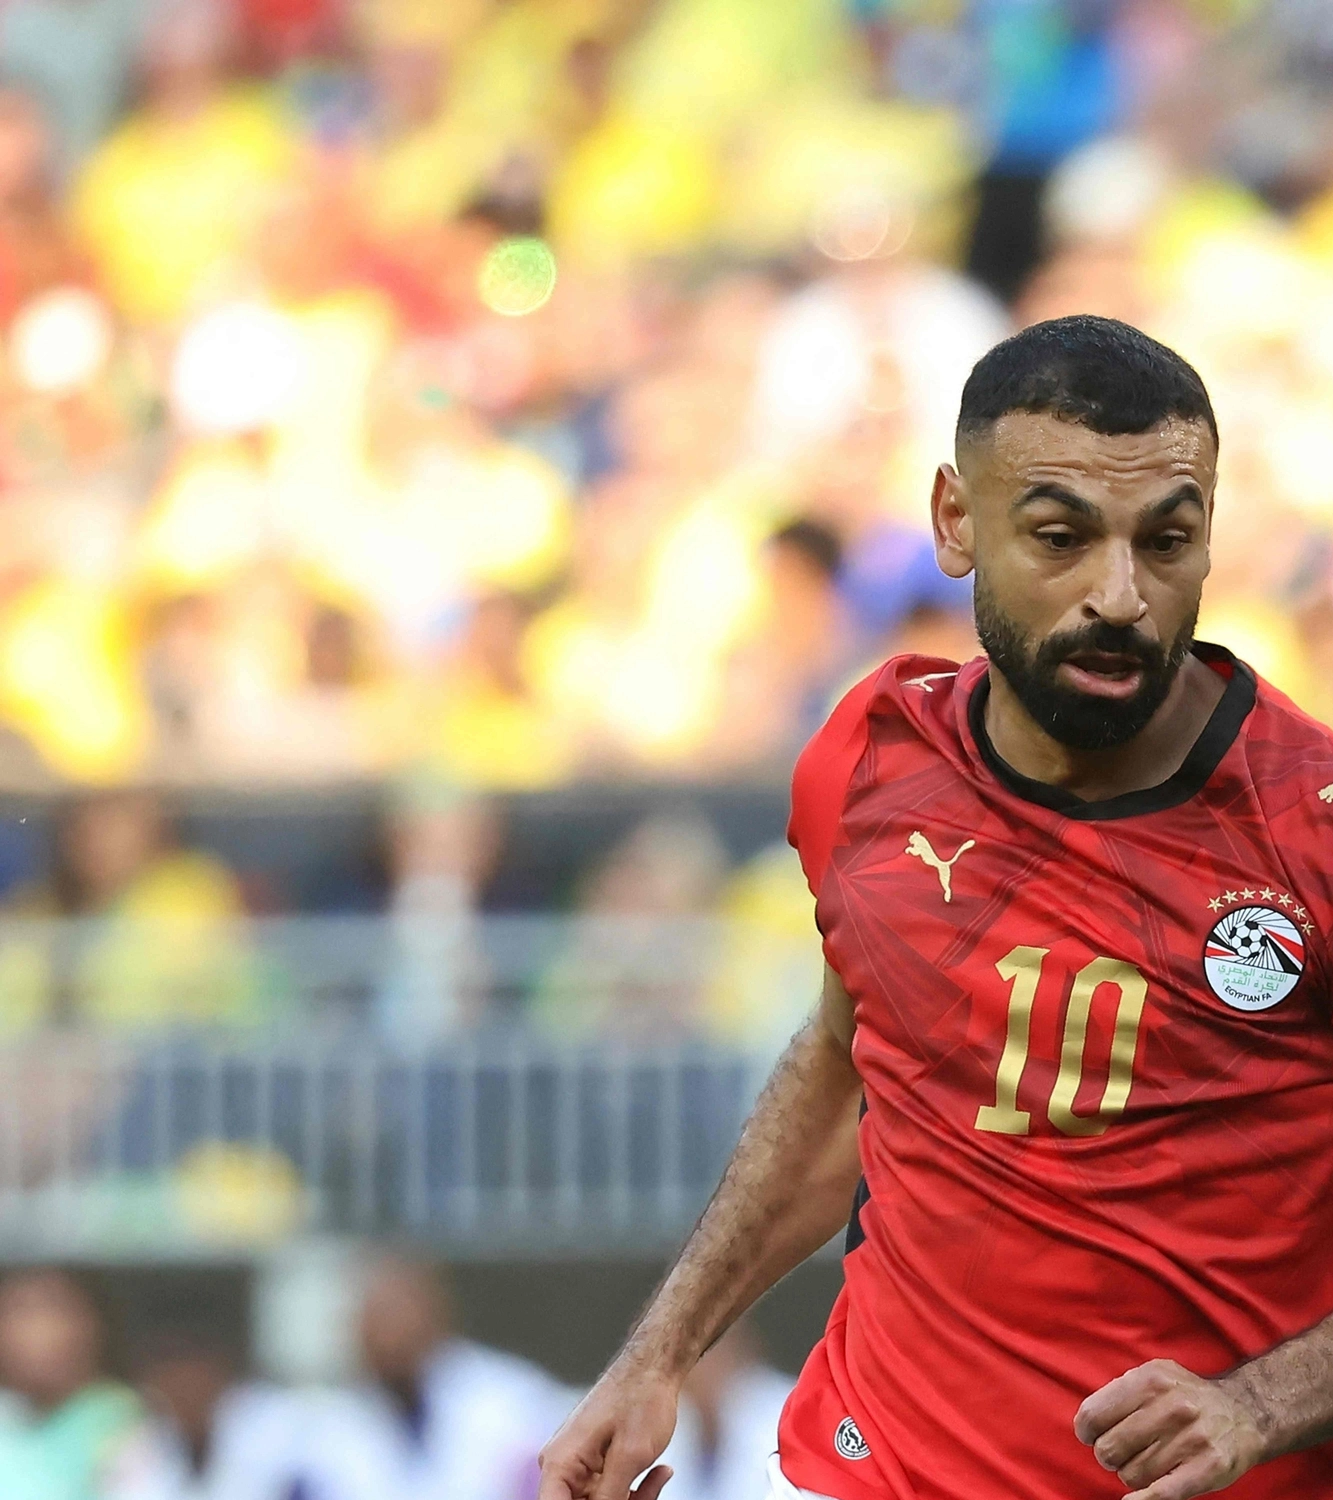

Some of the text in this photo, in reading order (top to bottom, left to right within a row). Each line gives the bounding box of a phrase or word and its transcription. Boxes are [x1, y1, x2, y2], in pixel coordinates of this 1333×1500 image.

[974, 945, 1148, 1136] 10
[1224, 985, 1273, 1003] EGYPTIAN FA
